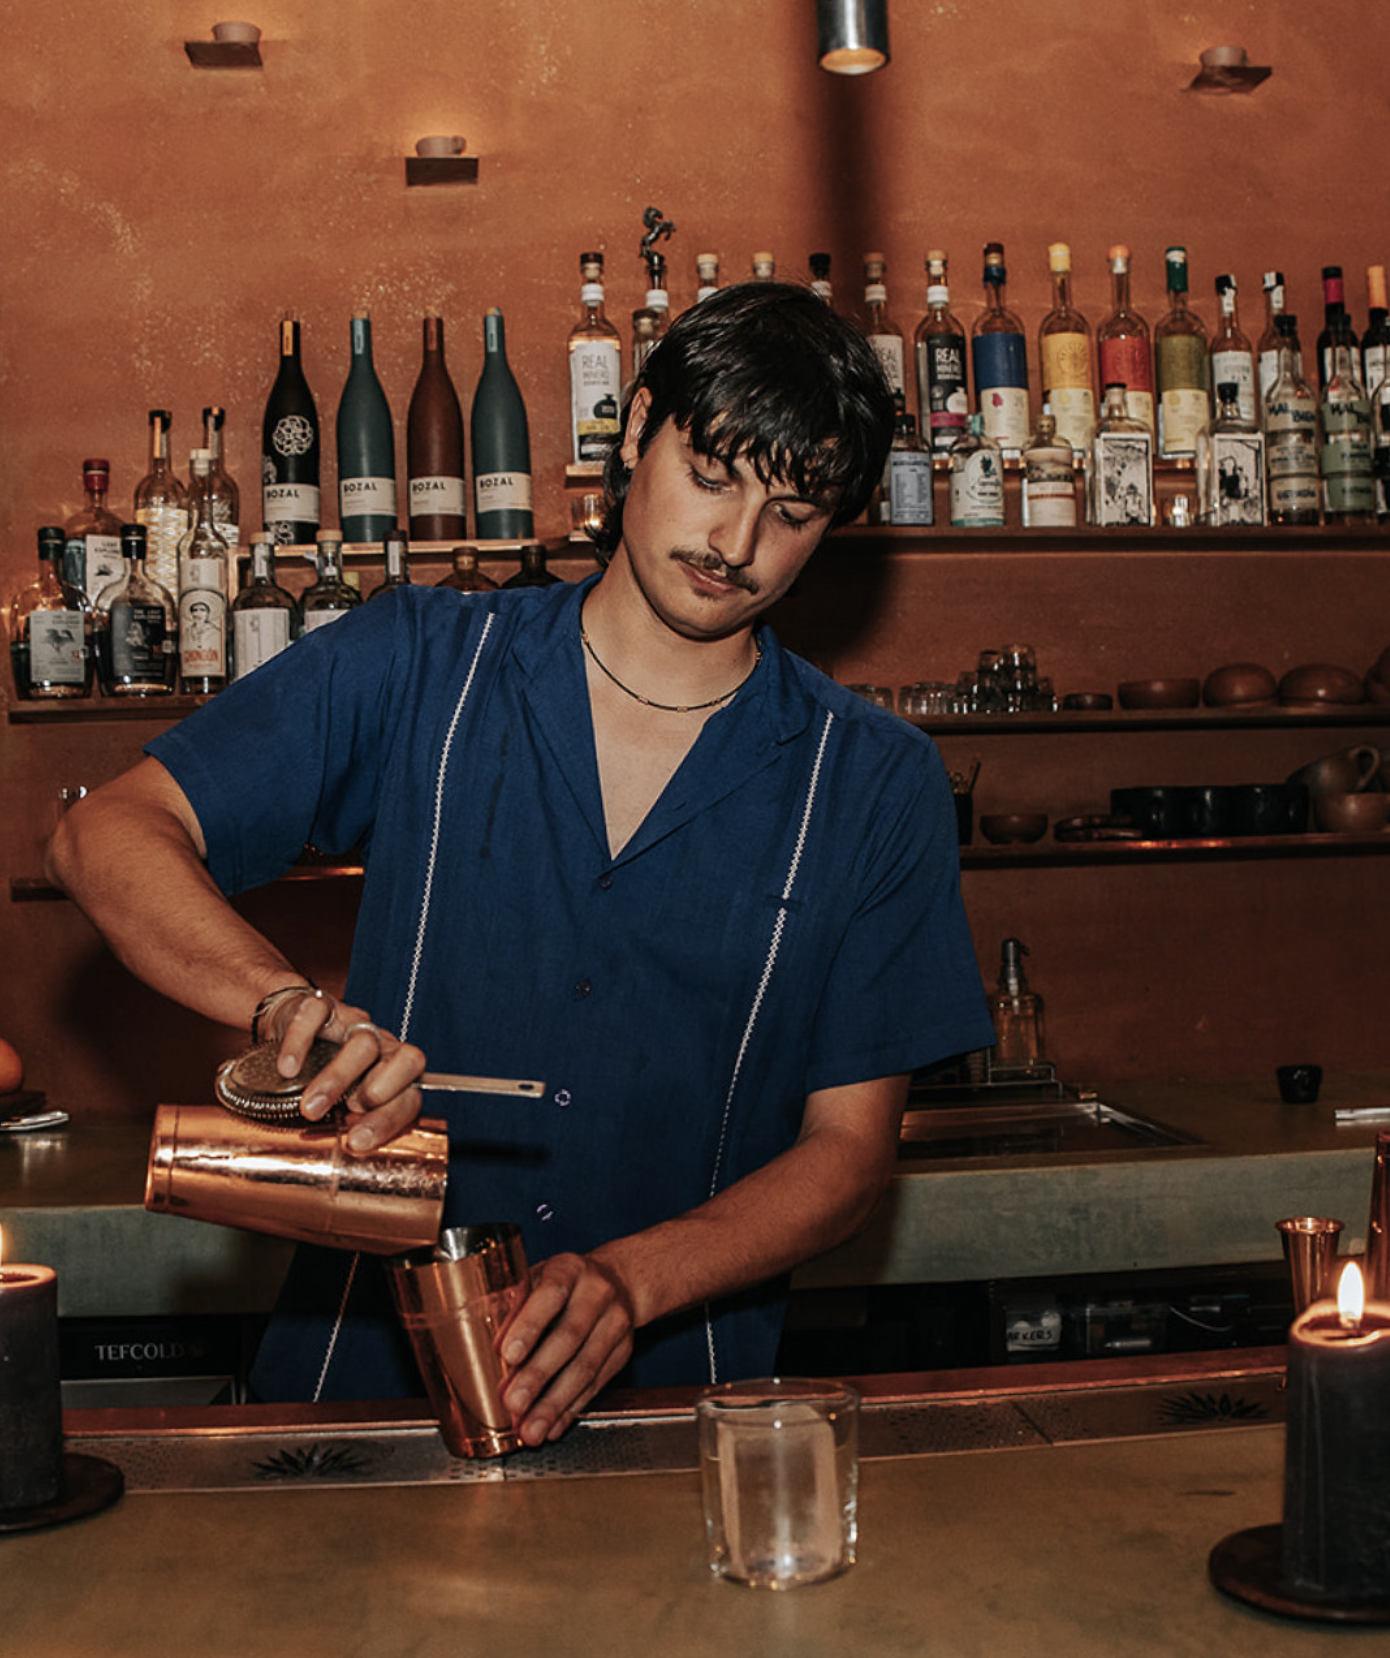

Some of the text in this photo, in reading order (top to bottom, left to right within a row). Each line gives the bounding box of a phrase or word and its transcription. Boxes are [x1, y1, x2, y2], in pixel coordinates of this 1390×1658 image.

[582, 355, 608, 370] REAL
[344, 482, 378, 493] BOZAL
[412, 481, 446, 492] BOZAL
[480, 477, 514, 488] BOZAL
[266, 488, 301, 499] BOZAL
[94, 1342, 185, 1360] TEFCOLD
